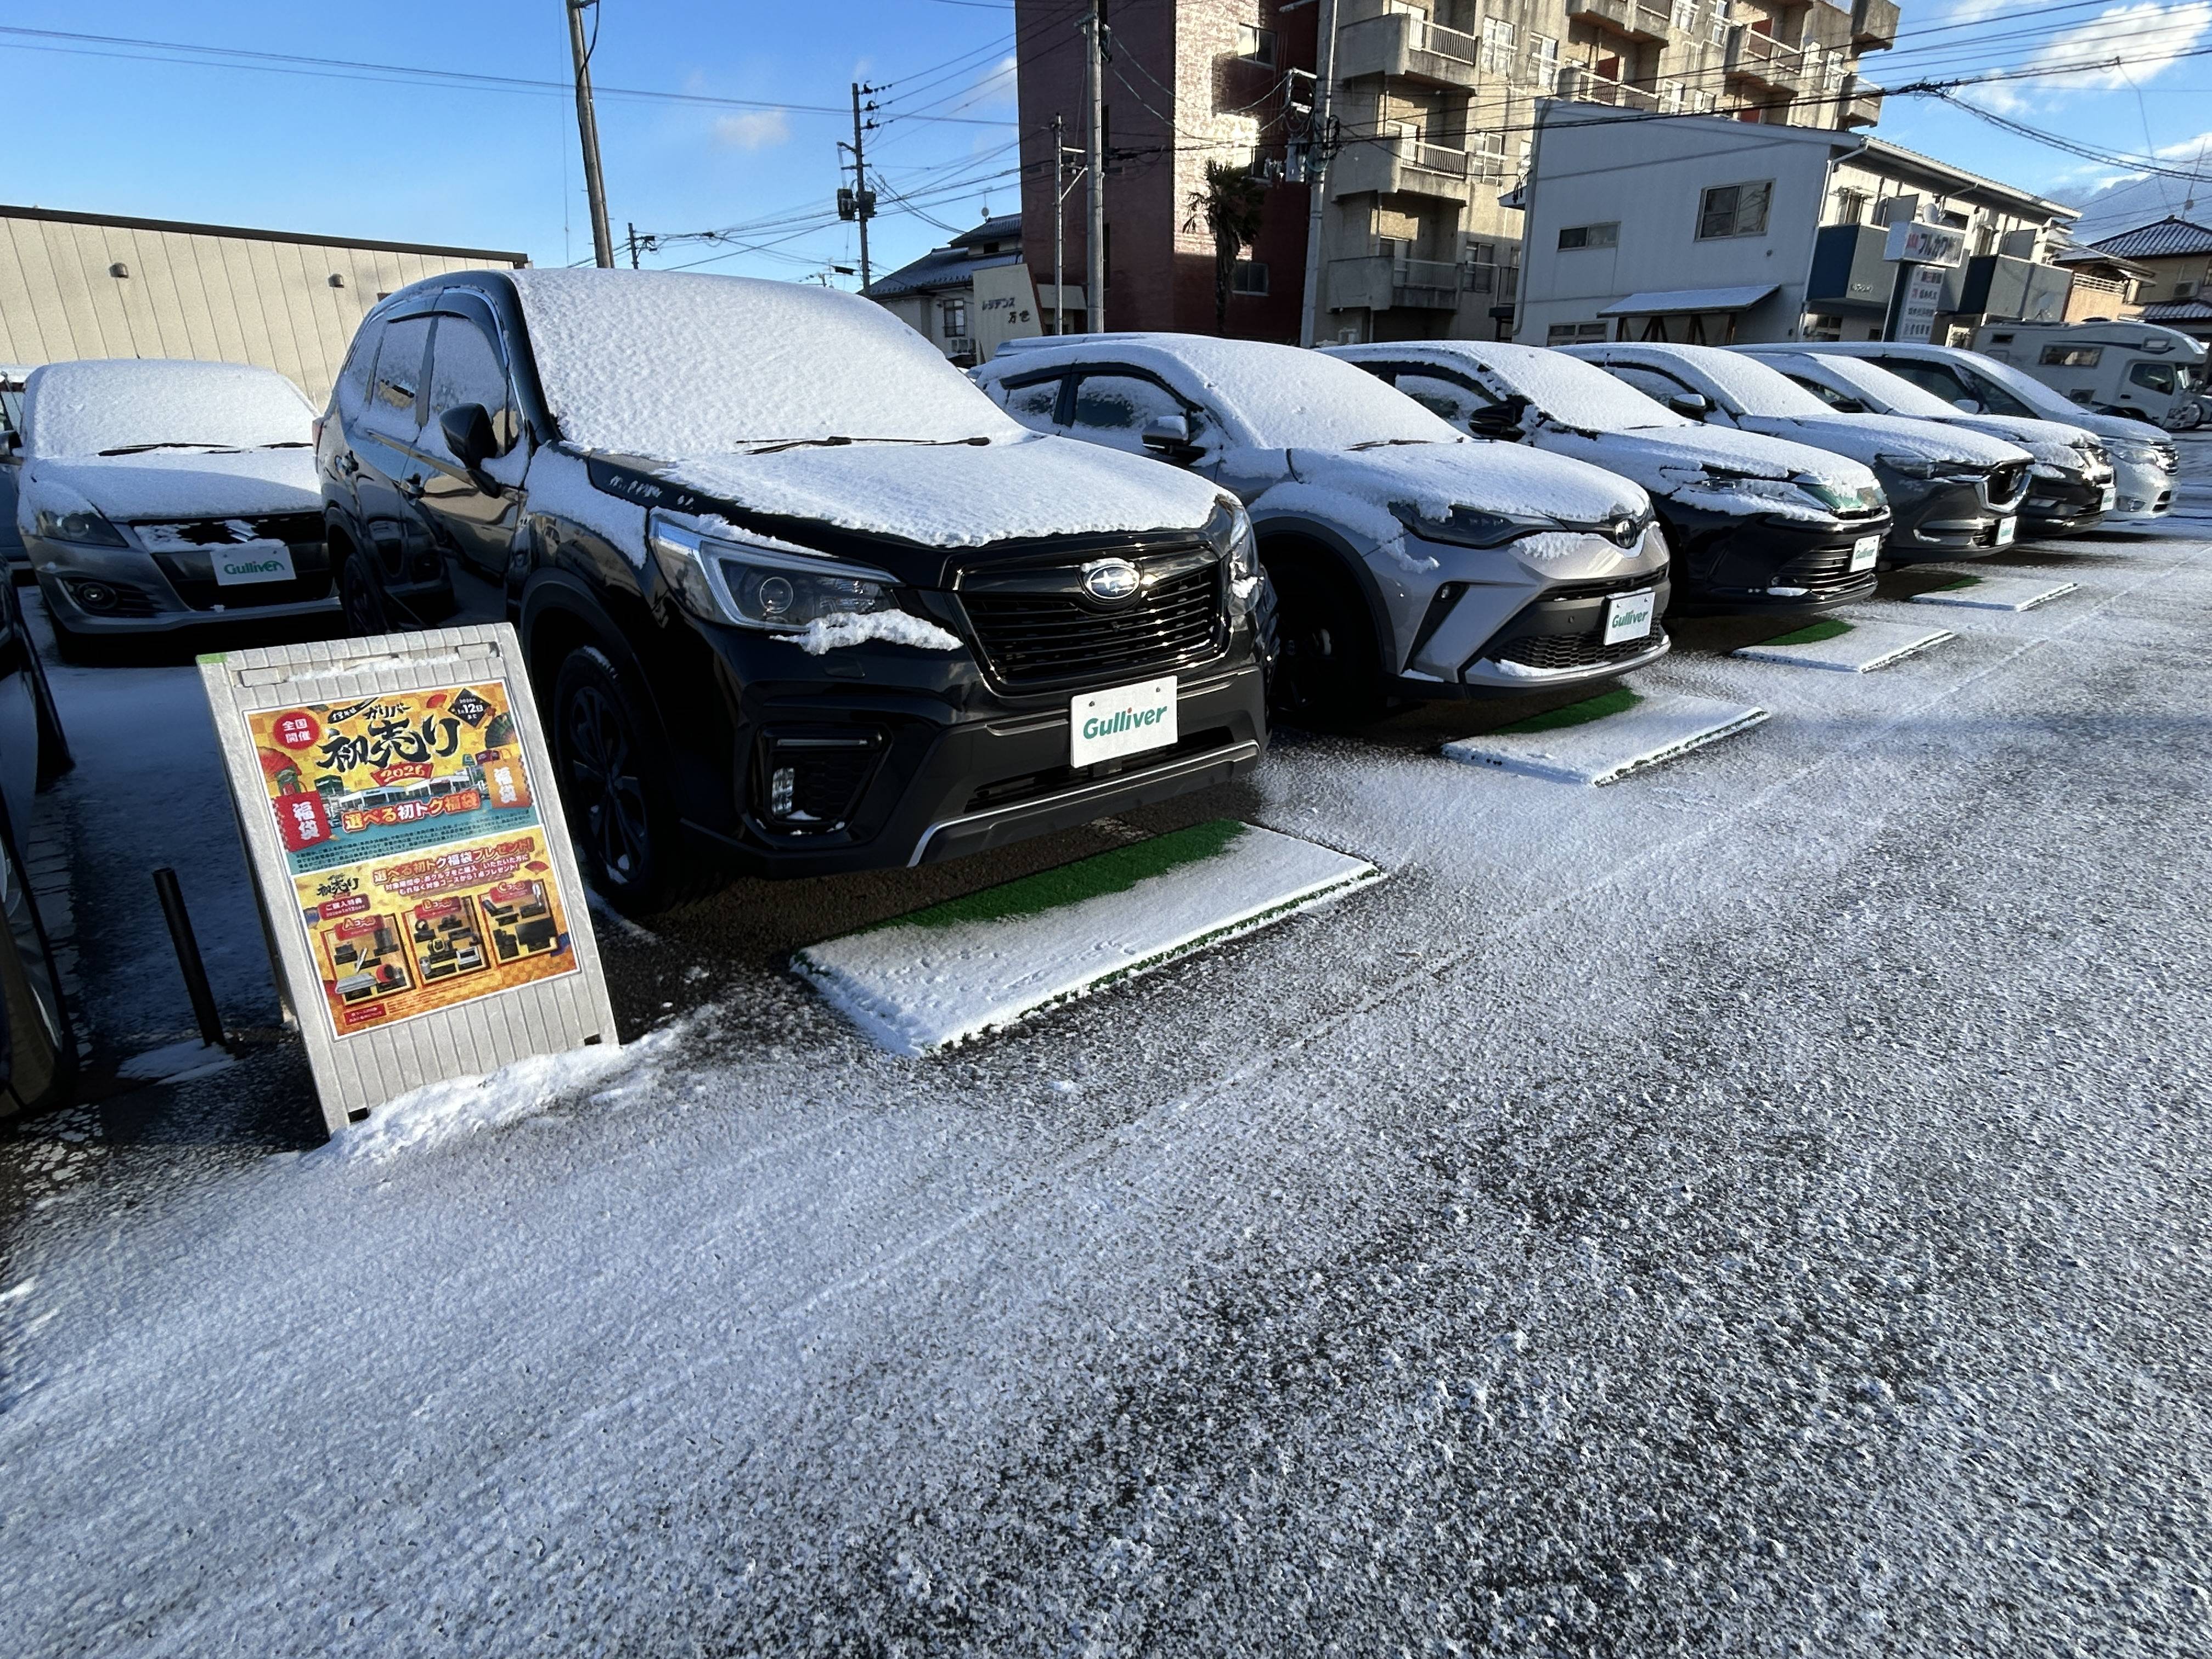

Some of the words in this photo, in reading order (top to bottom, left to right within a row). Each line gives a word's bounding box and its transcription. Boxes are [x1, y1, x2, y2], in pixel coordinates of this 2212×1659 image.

[982, 297, 1015, 311] レジデンス
[224, 560, 285, 575] Gulliver
[1612, 610, 1649, 628] Gulliver
[363, 703, 413, 720] ガリバー
[282, 719, 308, 730] 全国
[1083, 706, 1167, 740] Gulliver
[285, 730, 311, 743] 開催
[316, 714, 461, 772] 初売り
[380, 766, 425, 782] 2026
[493, 766, 518, 804] 福袋
[345, 791, 479, 830] 選べる初トク福袋
[292, 801, 320, 840] 福袋
